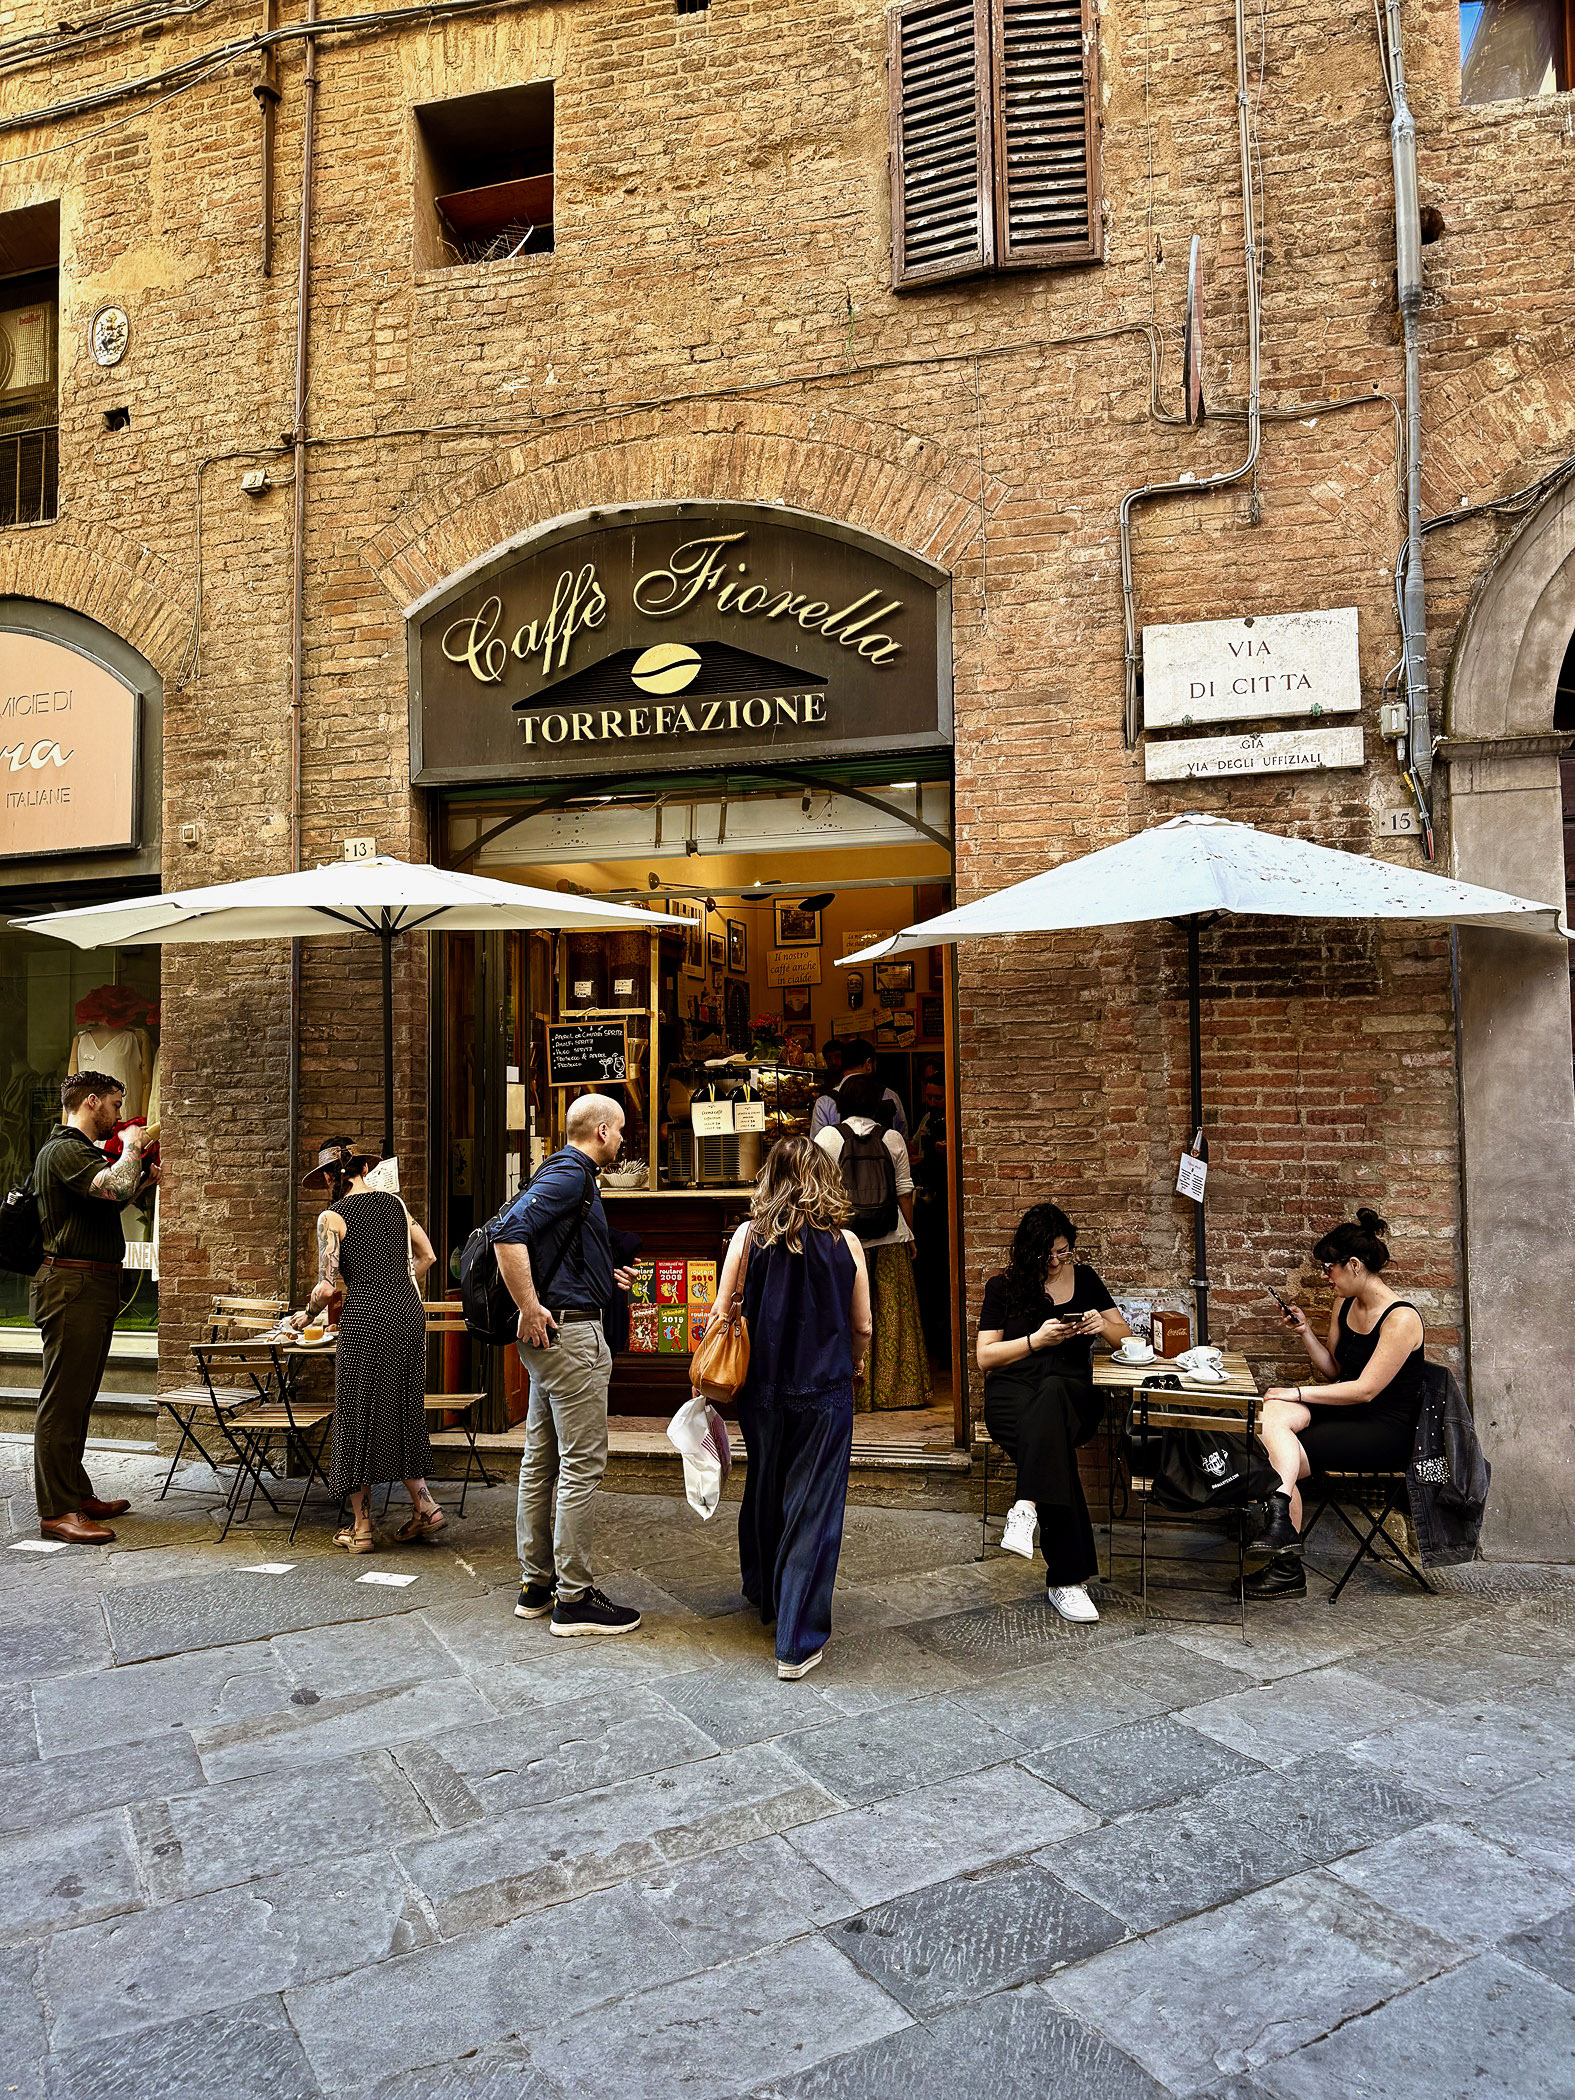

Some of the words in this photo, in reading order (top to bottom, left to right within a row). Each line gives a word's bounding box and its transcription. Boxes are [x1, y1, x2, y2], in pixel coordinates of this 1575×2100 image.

[441, 563, 606, 682] Caffè
[633, 530, 904, 666] Fiorella
[1227, 640, 1271, 657] VIA
[1190, 681, 1214, 699] DI
[53, 690, 73, 712] DI
[517, 692, 827, 745] TORREFAZIONE
[1187, 763, 1208, 772] VIA
[1217, 759, 1254, 770] DEGLI
[1263, 753, 1321, 766] UFFIZIALI
[6, 787, 71, 808] ITALIANE
[1390, 812, 1411, 830] 15
[353, 842, 367, 857] 13
[775, 951, 782, 961] Il
[783, 951, 809, 960] nostro
[793, 960, 817, 972] anche
[777, 976, 785, 985] in
[788, 972, 812, 984] cialde
[574, 1038, 594, 1046] SPRITZ
[603, 1029, 623, 1037] SPRITZ
[123, 1242, 159, 1268] INEN
